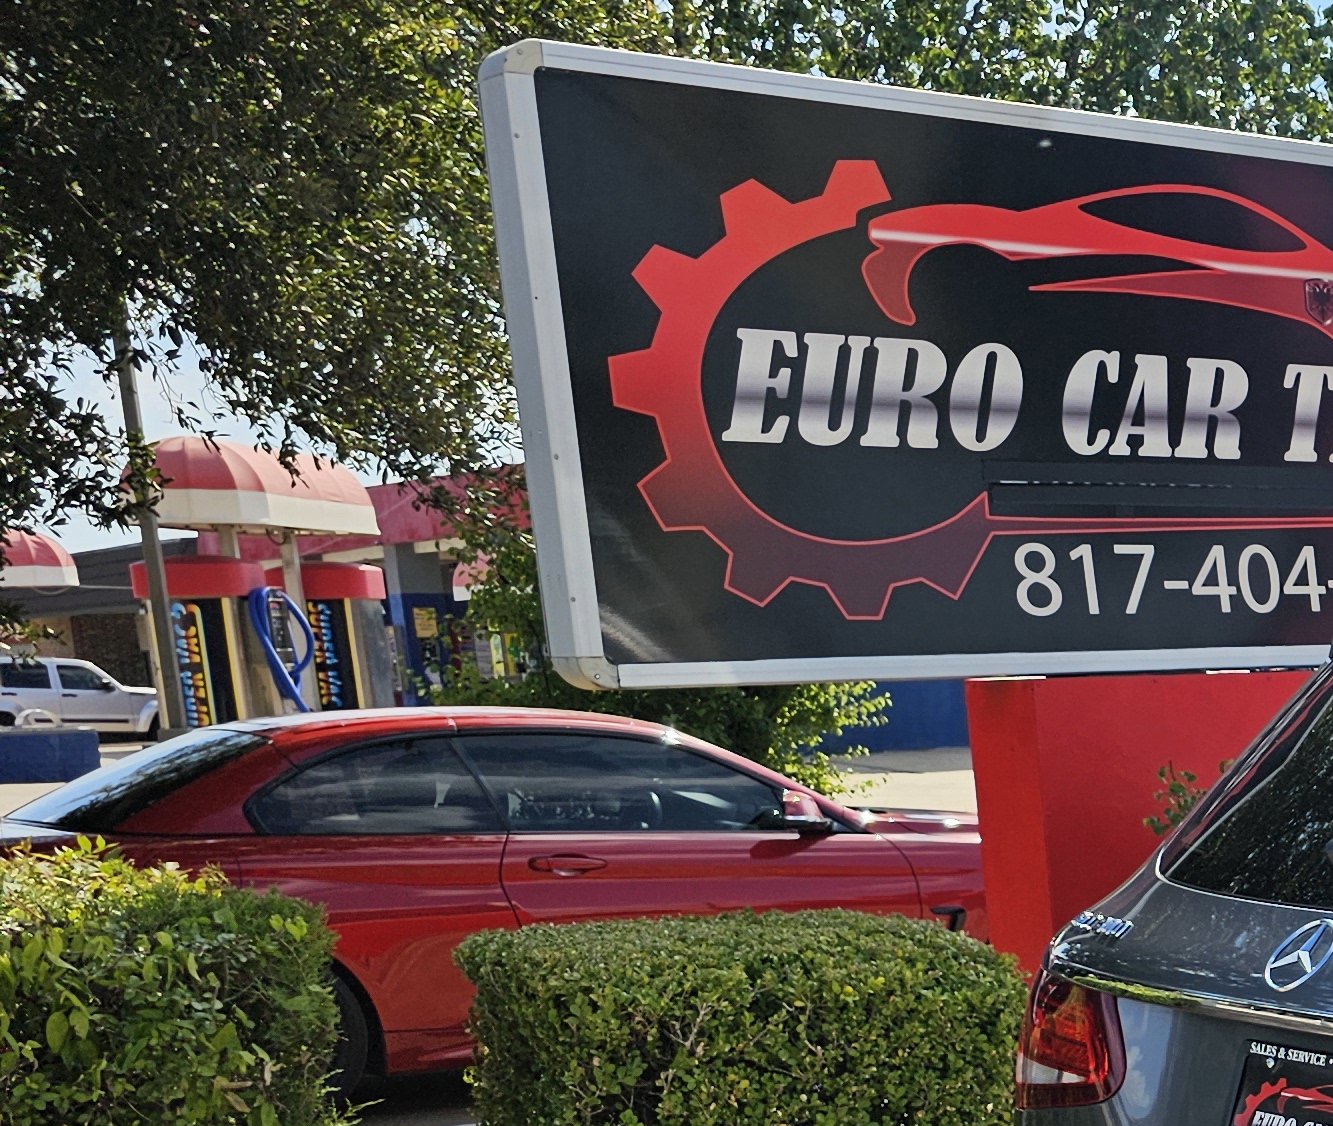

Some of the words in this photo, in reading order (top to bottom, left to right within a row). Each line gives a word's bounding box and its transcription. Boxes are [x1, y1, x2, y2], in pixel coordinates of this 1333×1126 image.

[721, 327, 1023, 452] EURO
[1062, 349, 1250, 461] CAR
[174, 623, 202, 664] VAC
[318, 671, 343, 708] VAC
[1250, 1042, 1278, 1058] SALES
[1278, 1047, 1286, 1059] &
[1287, 1049, 1327, 1067] SERVICE
